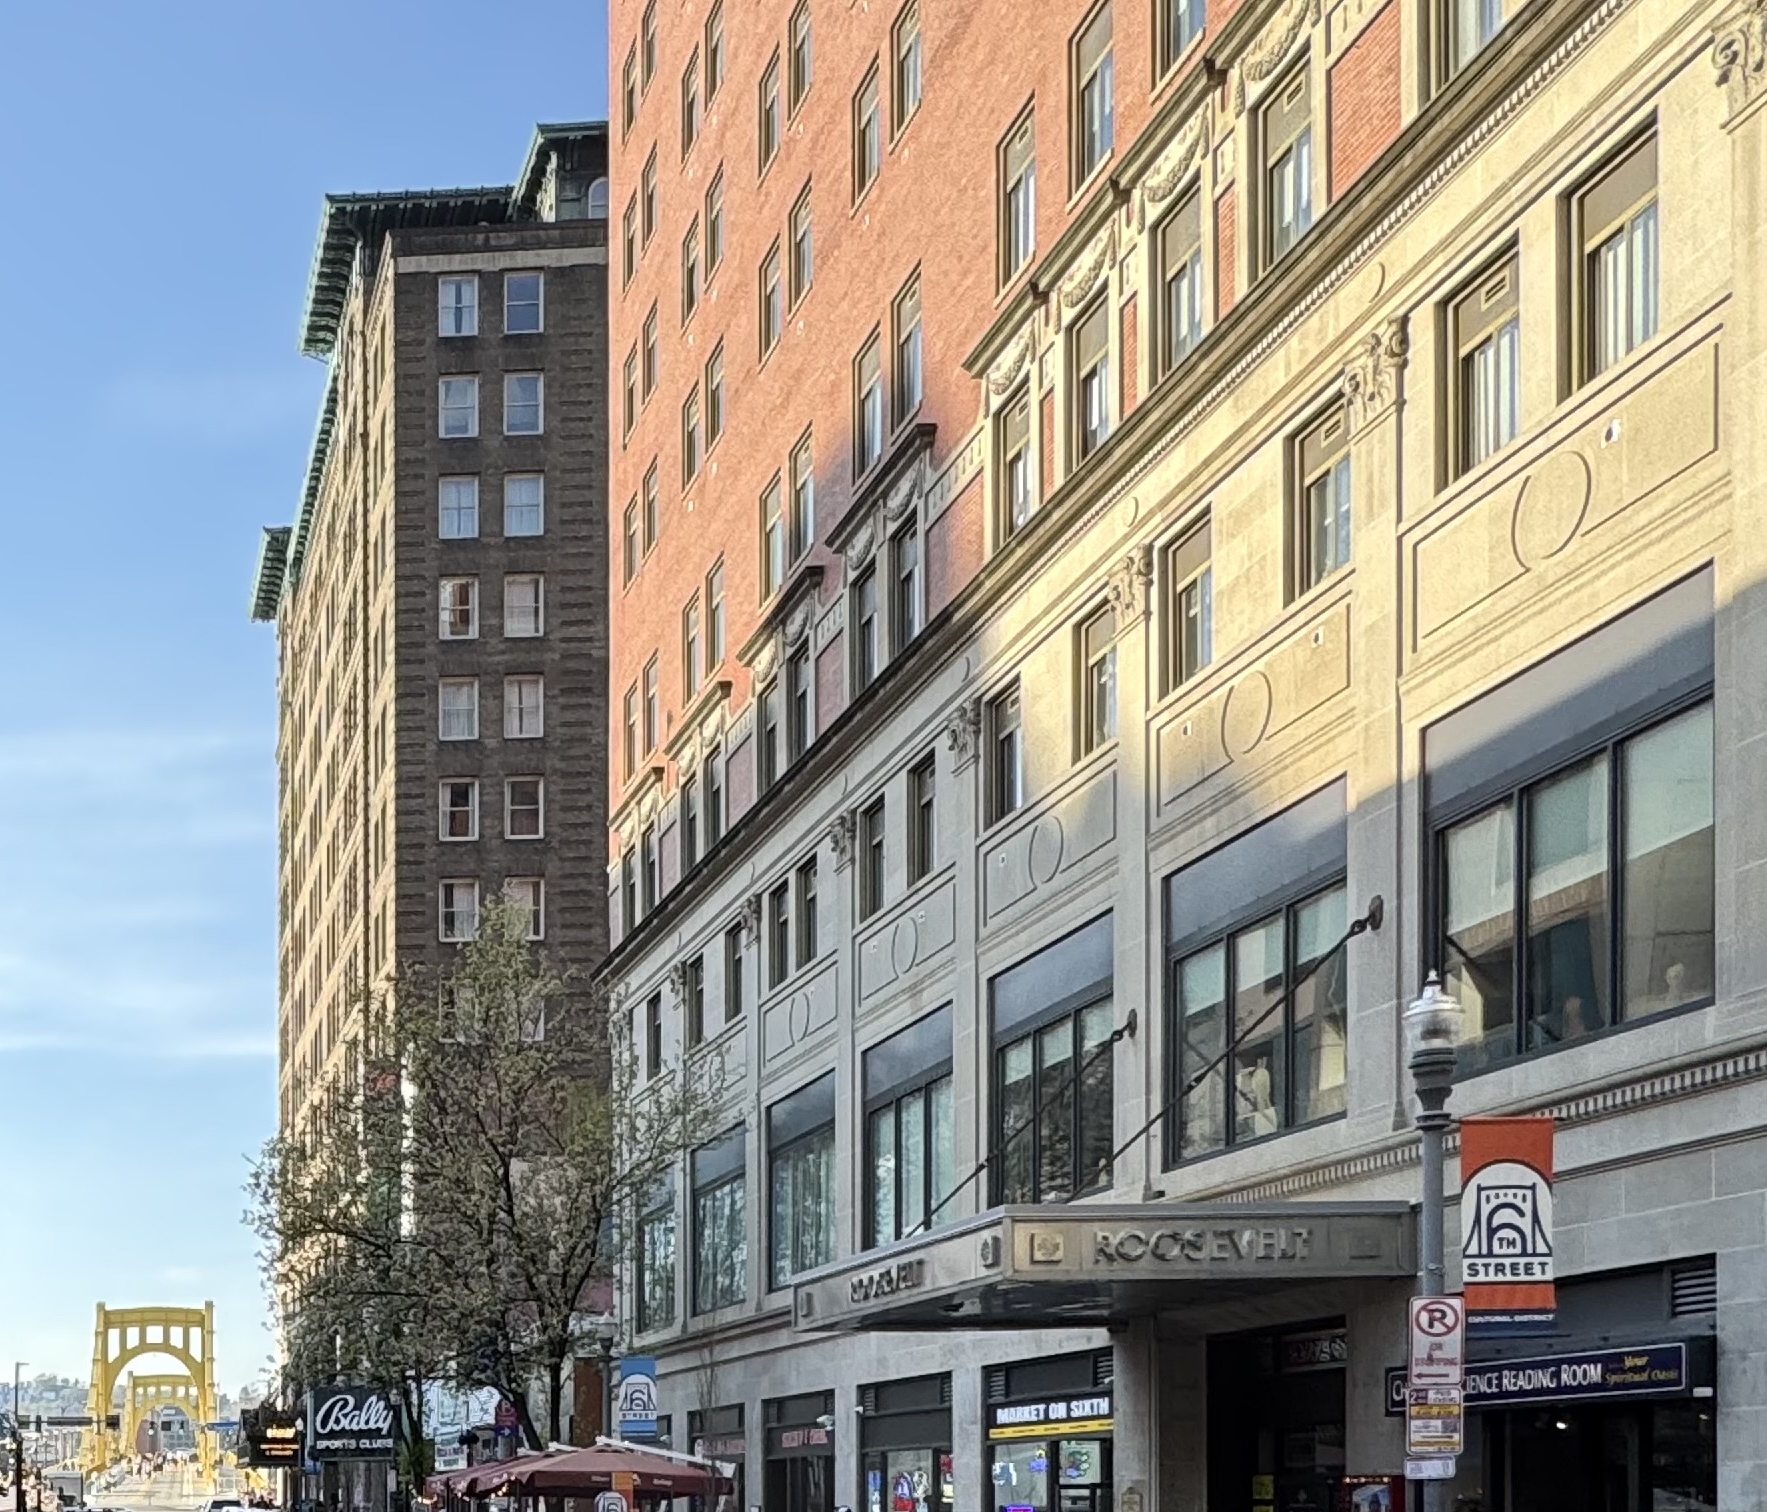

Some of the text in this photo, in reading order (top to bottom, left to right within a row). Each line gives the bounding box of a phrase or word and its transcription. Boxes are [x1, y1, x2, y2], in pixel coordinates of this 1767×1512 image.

[1092, 1228, 1311, 1264] ROOSEVELT
[1466, 1261, 1550, 1278] STREET
[1465, 1363, 1603, 1393] IENCE READING ROOM
[315, 1394, 394, 1436] Bally
[996, 1397, 1110, 1425] MARKET ON SIXTH
[316, 1438, 394, 1450] SPORTS CLUBS
